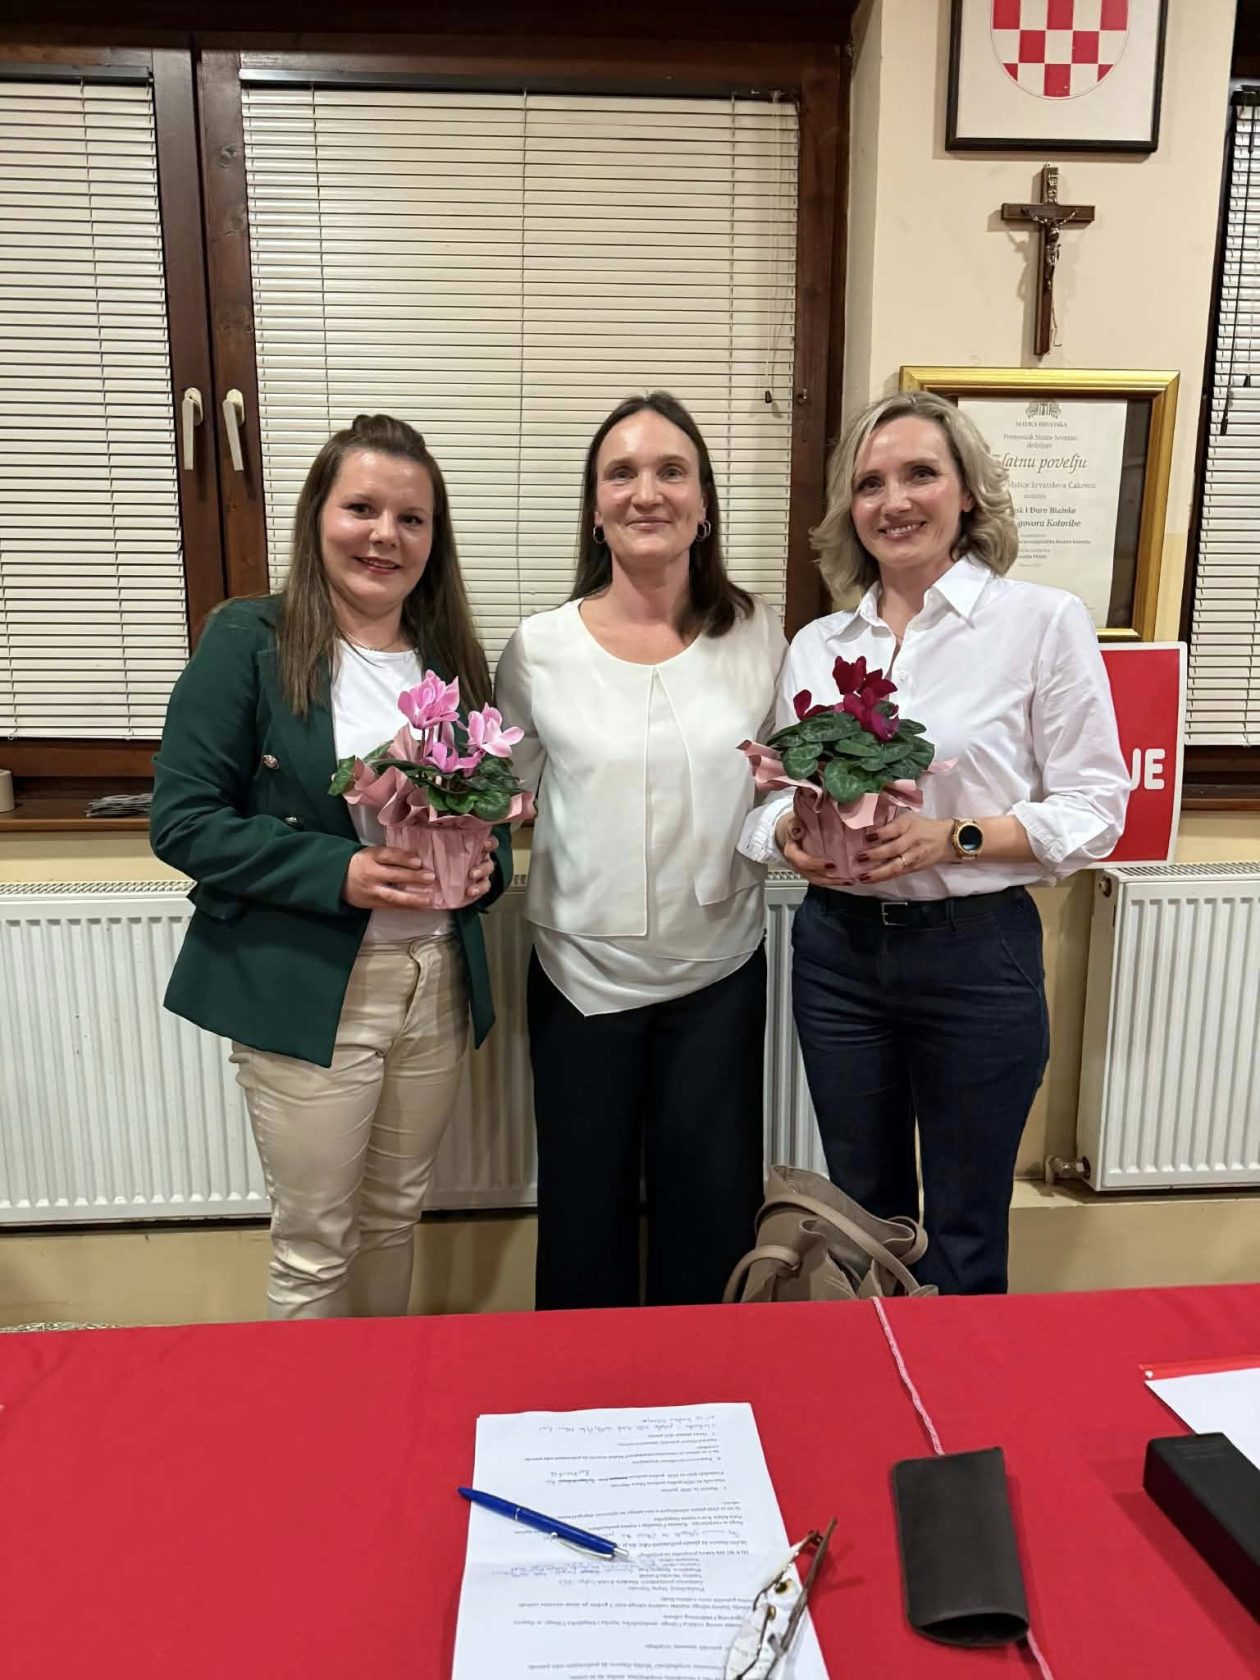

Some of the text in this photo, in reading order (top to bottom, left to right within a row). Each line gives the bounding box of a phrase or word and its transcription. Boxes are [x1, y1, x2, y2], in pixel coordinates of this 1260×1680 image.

[995, 453, 1088, 474] latnu povelju
[1017, 519, 1082, 529] govora Kotoribe
